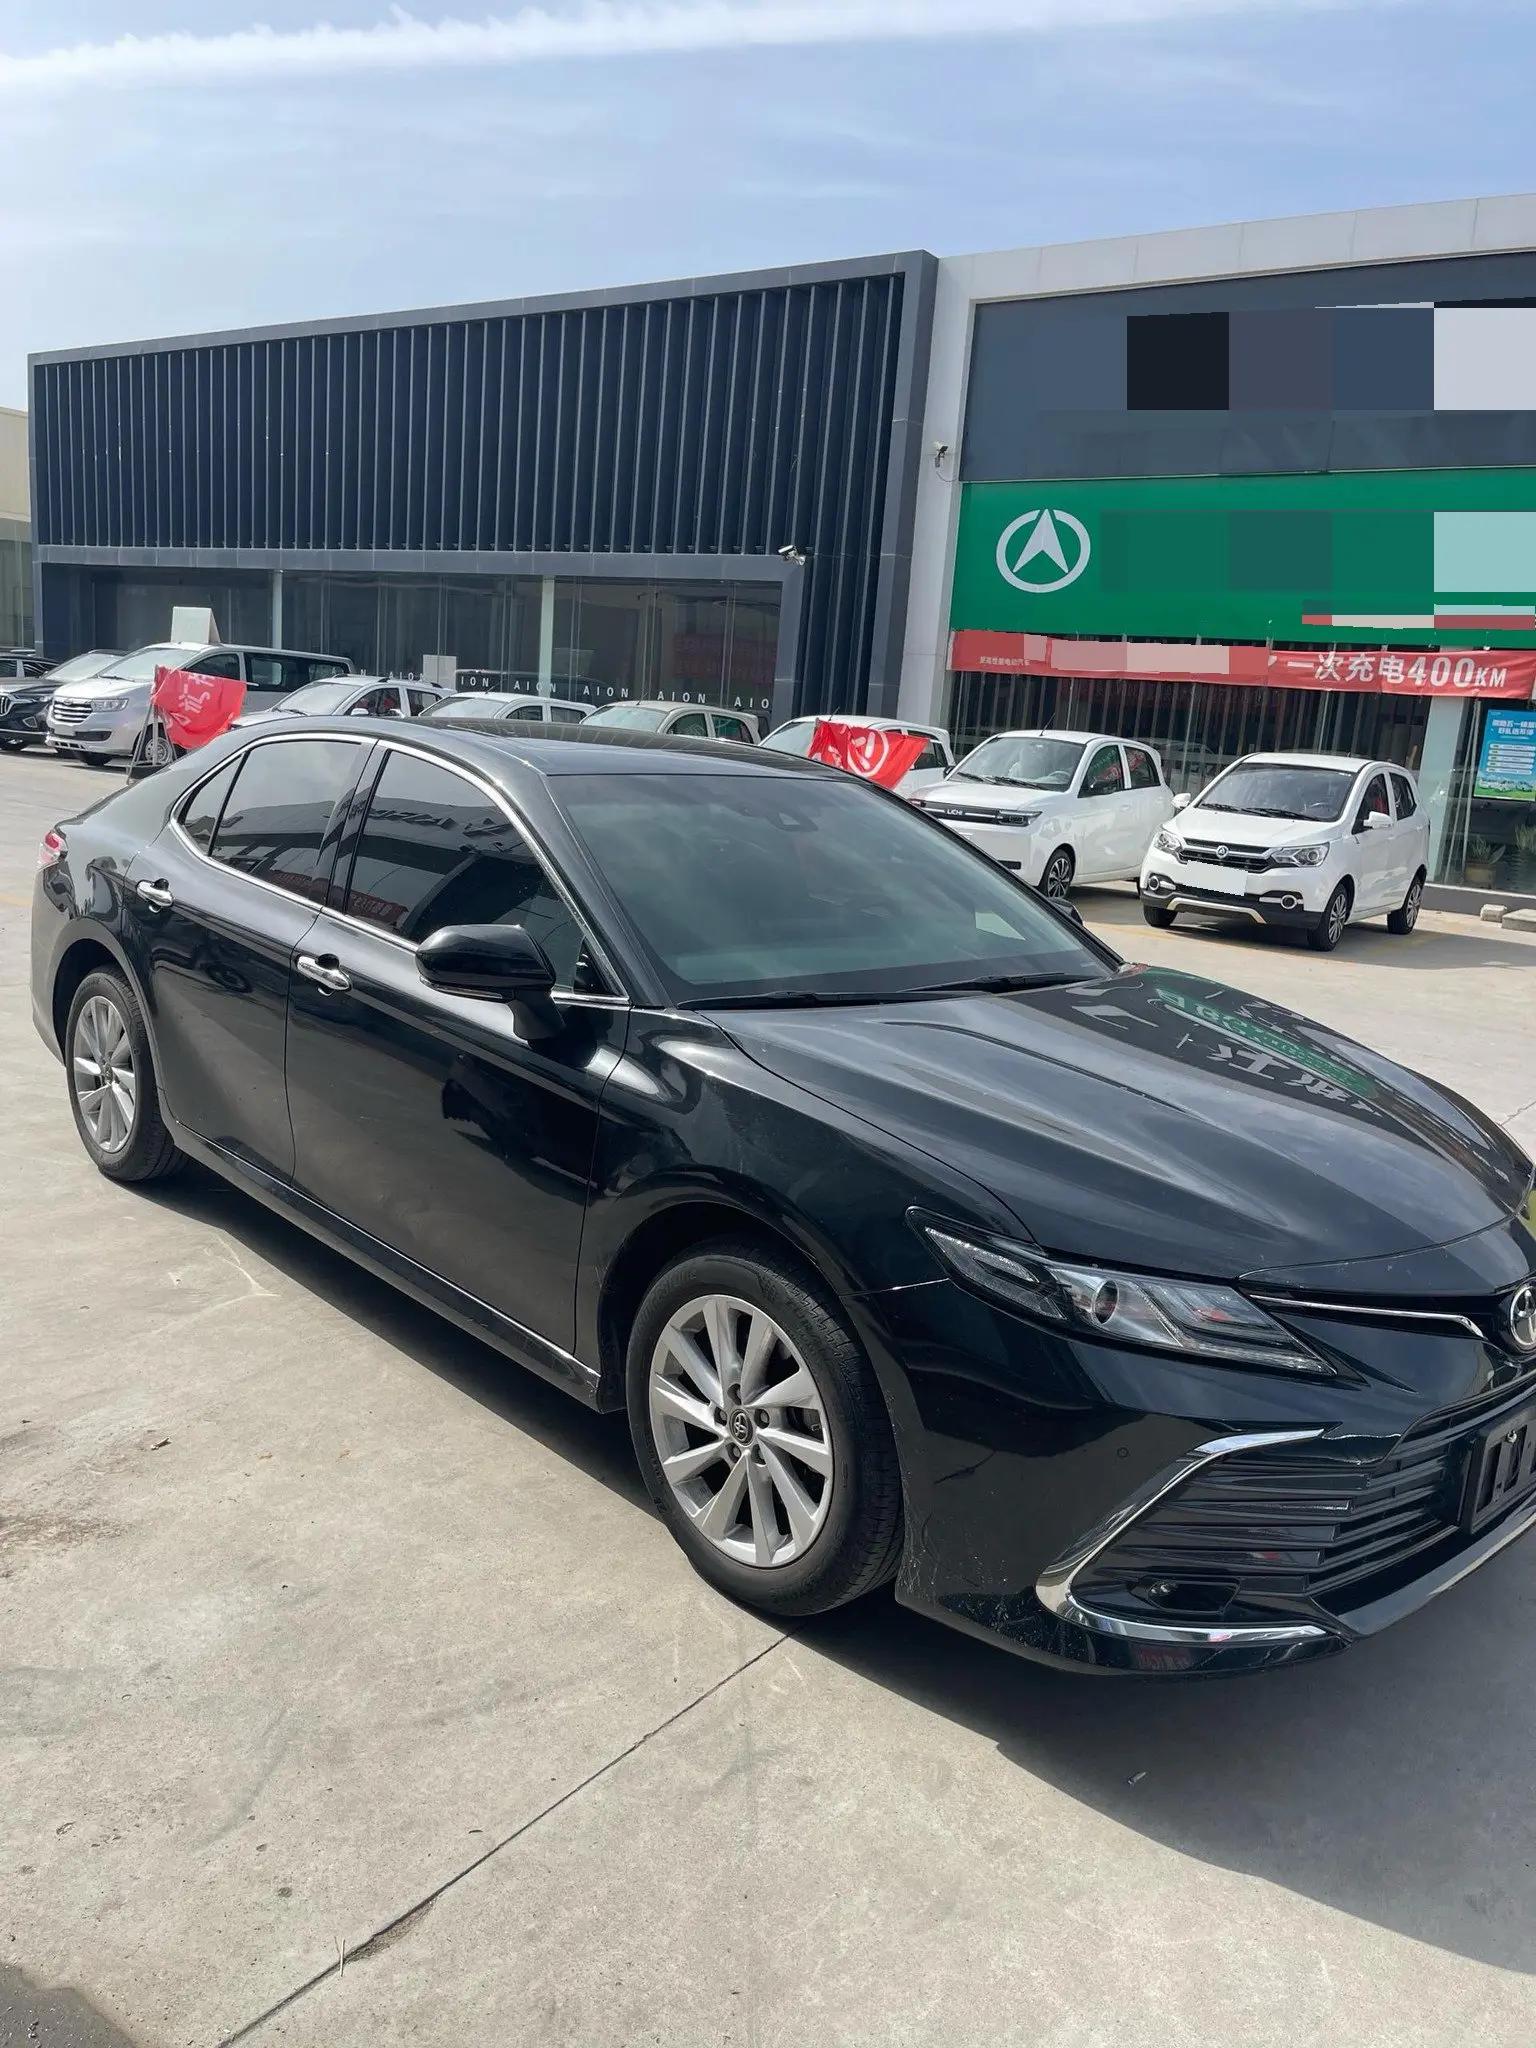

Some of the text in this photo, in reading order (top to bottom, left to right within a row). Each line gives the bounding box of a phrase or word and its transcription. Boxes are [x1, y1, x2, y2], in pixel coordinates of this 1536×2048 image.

[513, 680, 557, 693] AION
[582, 685, 630, 699] AION
[657, 690, 706, 704] AION
[734, 696, 770, 710] AIO
